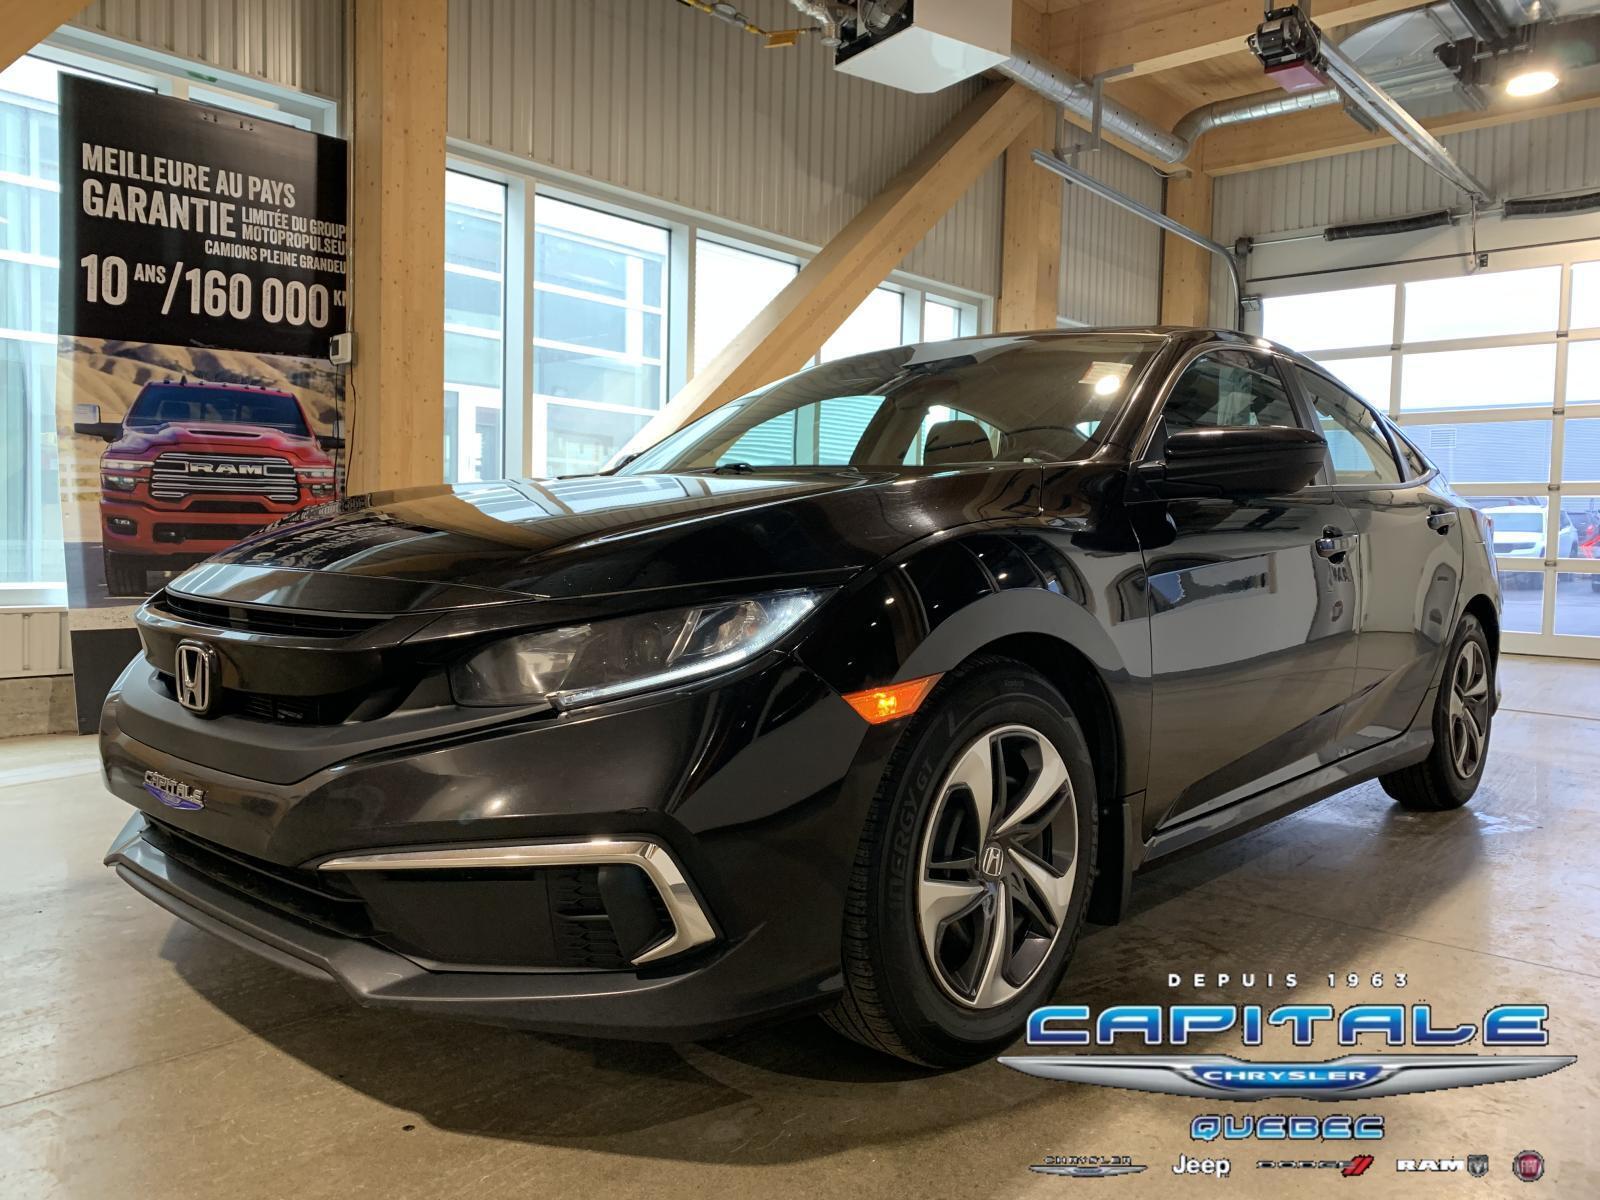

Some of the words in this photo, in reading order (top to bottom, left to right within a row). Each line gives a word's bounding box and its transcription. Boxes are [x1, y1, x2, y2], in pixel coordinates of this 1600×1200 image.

[82, 143, 210, 192] MEILLEURE
[216, 170, 243, 198] AU
[249, 176, 296, 208] PAYS
[82, 178, 236, 238] GARANTIE
[242, 206, 289, 230] LIMITÉE
[292, 213, 307, 233] DU
[310, 220, 346, 239] GROUP
[205, 240, 258, 262] CAMIONS
[260, 247, 298, 267] PLEINE
[300, 254, 346, 274] GRANDEU
[242, 224, 346, 256] MOTOPROPULSEU
[81, 253, 128, 306] 10
[262, 277, 329, 328] 000
[190, 462, 264, 475] RAM
